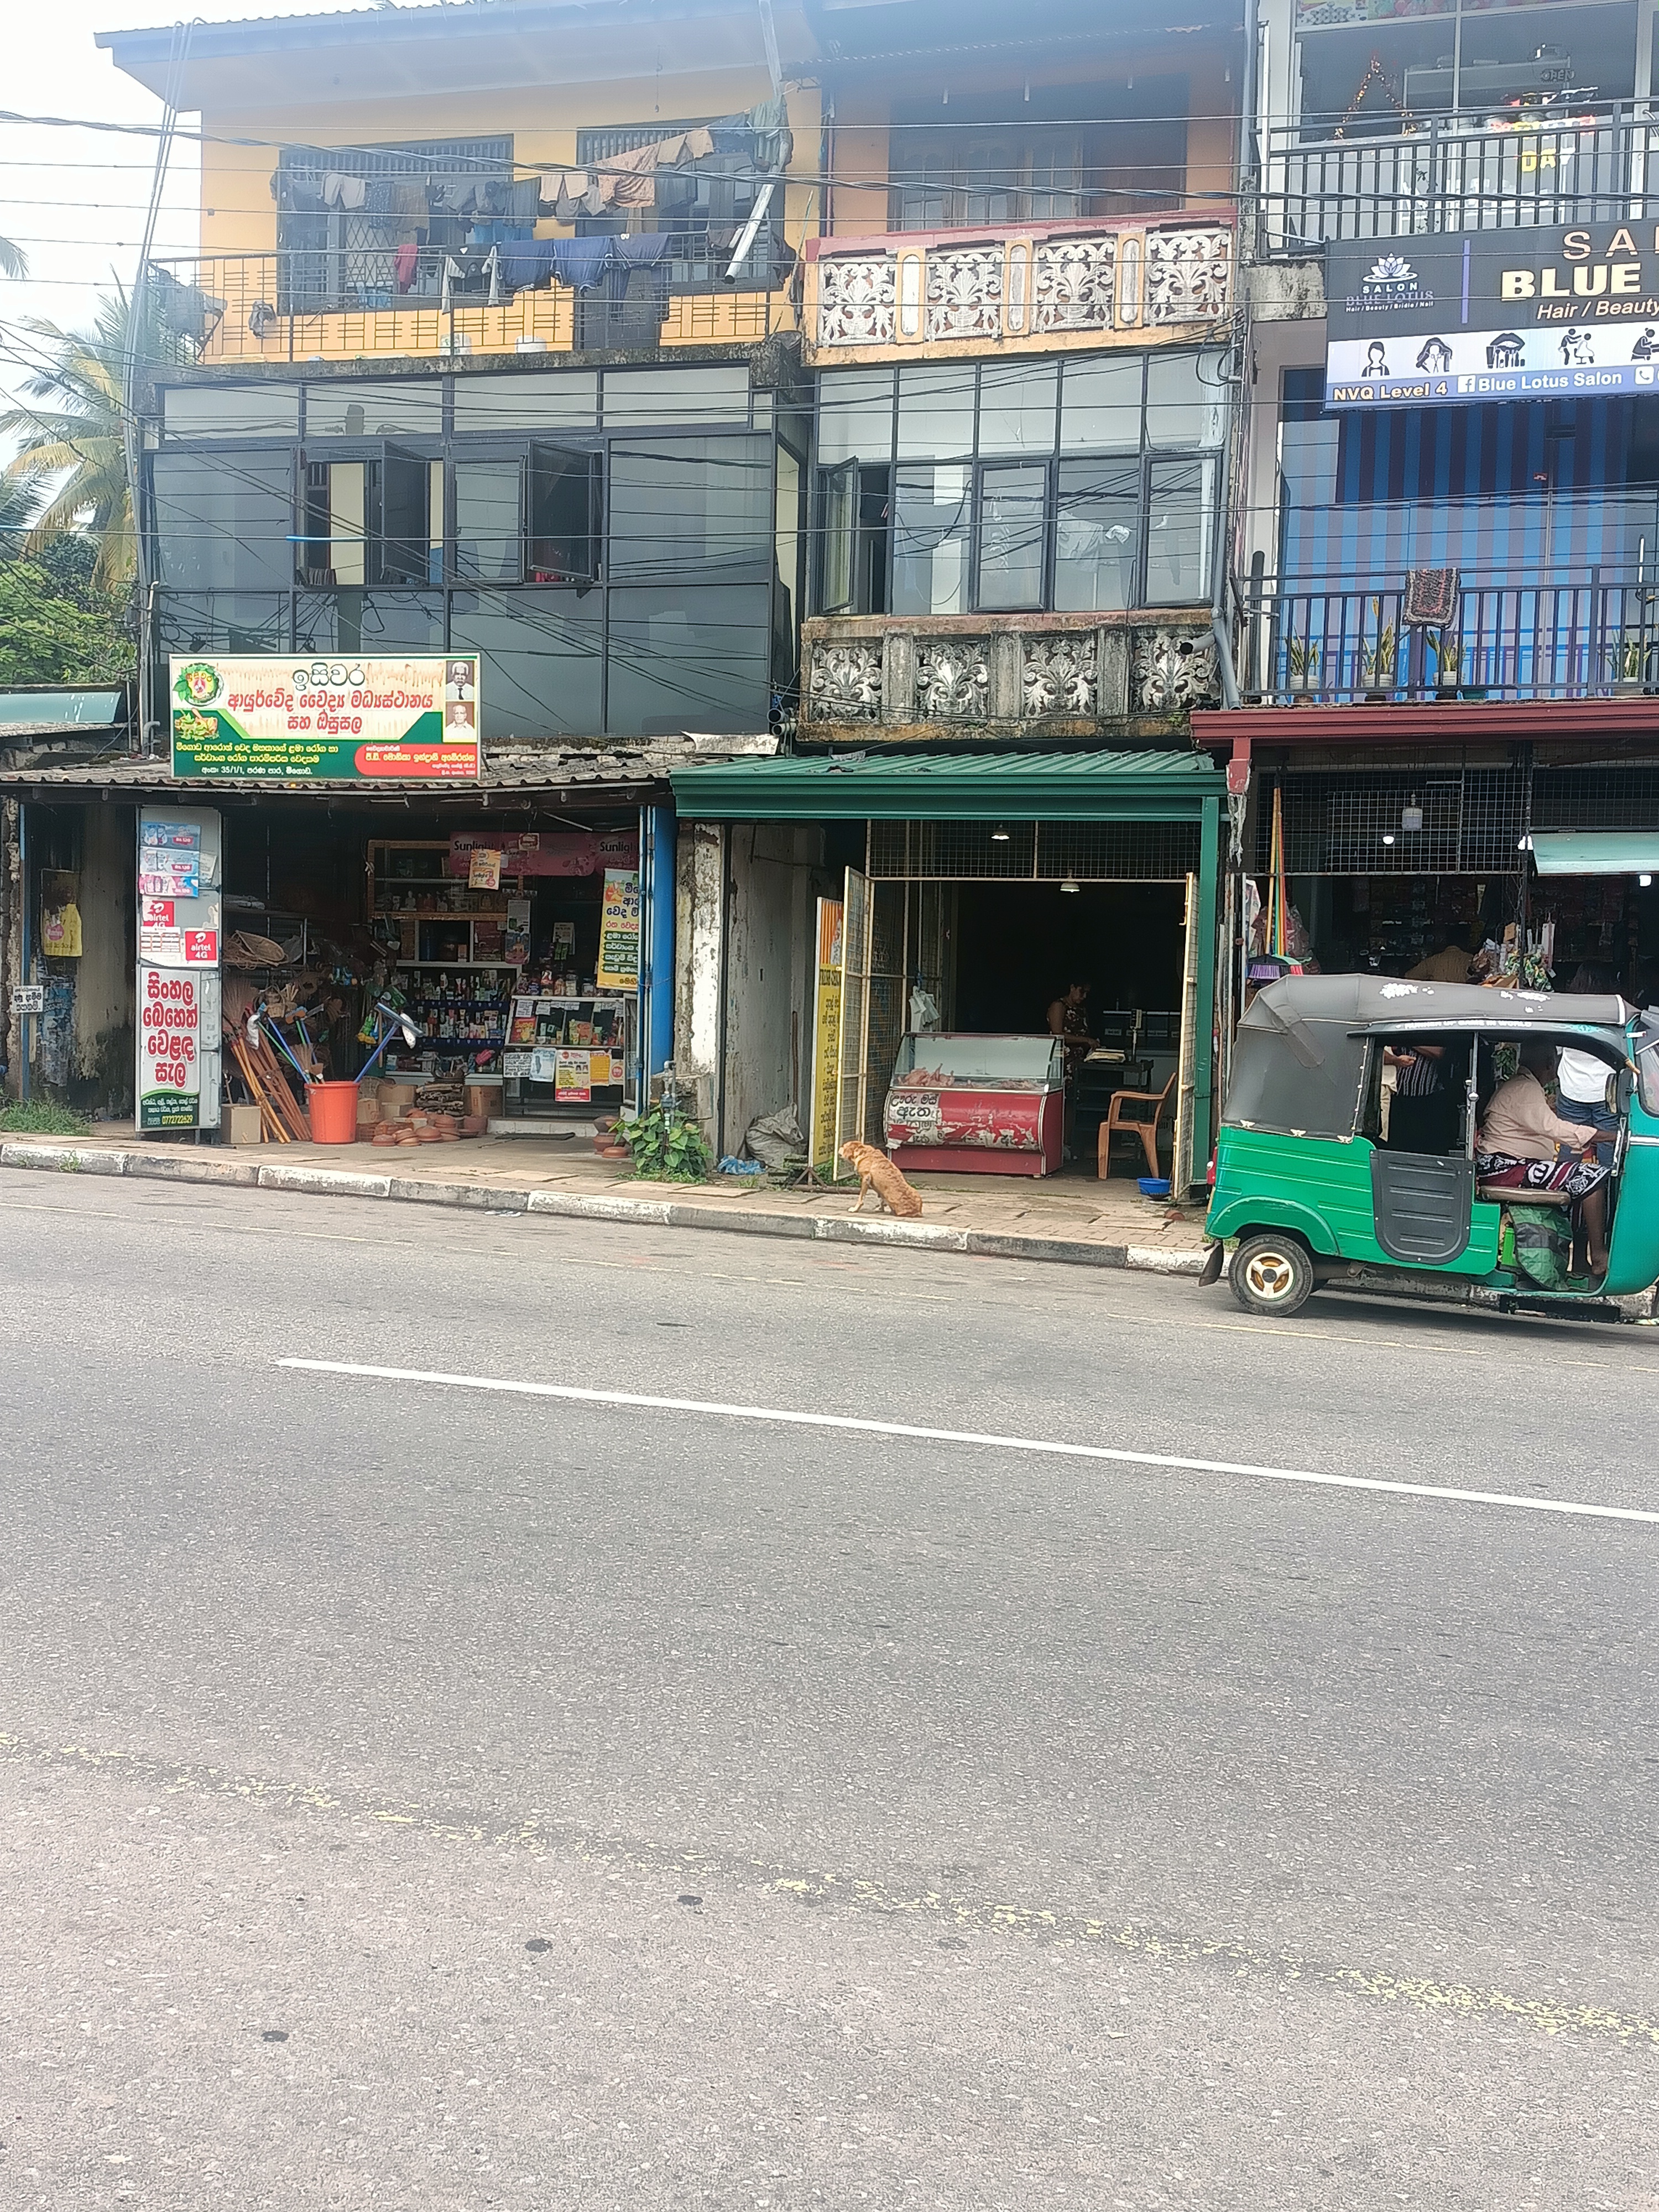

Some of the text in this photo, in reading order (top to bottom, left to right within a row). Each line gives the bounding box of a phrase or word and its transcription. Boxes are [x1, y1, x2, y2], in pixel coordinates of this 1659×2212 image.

[1362, 282, 1418, 294] SALON
[1501, 262, 1641, 301] BLUE
[1536, 302, 1578, 320] Hair
[1333, 381, 1448, 401] NVQ Level 4
[1478, 377, 1516, 392] Blue
[1521, 374, 1569, 390] Lotus
[1573, 371, 1622, 387] Salon
[292, 662, 366, 691] ඉසිවර
[227, 687, 294, 712] ආයුර්වේද
[287, 716, 311, 730] සහ
[607, 906, 627, 919] වෙද
[190, 943, 211, 951] airtel
[147, 971, 194, 1006] සිංහල
[143, 1001, 198, 1029] බෙහෙත්
[155, 1062, 186, 1088] සැල
